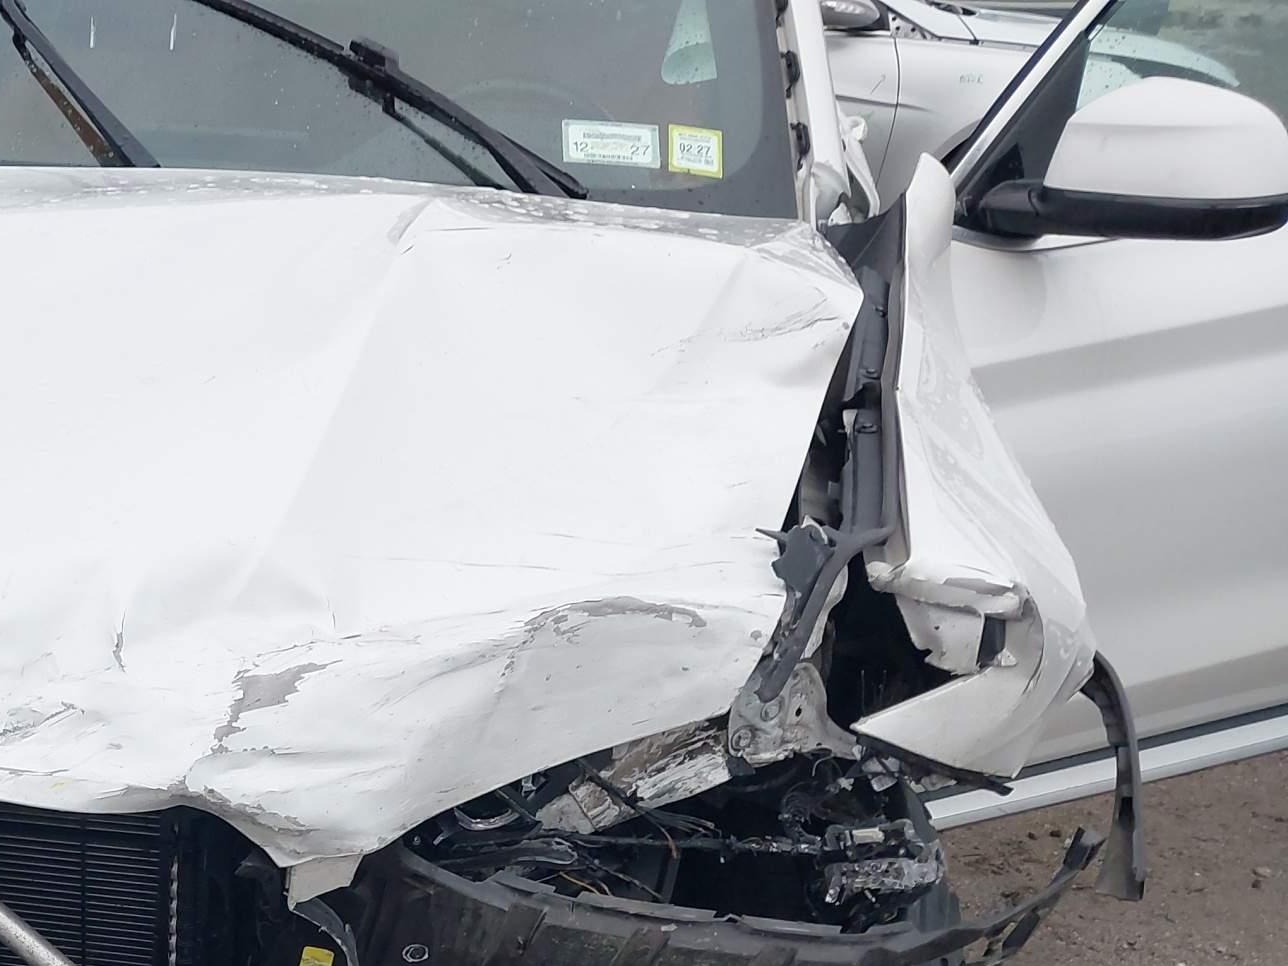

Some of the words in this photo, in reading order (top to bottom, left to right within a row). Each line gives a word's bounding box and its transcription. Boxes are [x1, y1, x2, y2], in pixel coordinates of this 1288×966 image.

[572, 141, 589, 153] 12
[630, 144, 650, 156] 27
[679, 143, 693, 153] 02
[697, 144, 712, 155] 27
